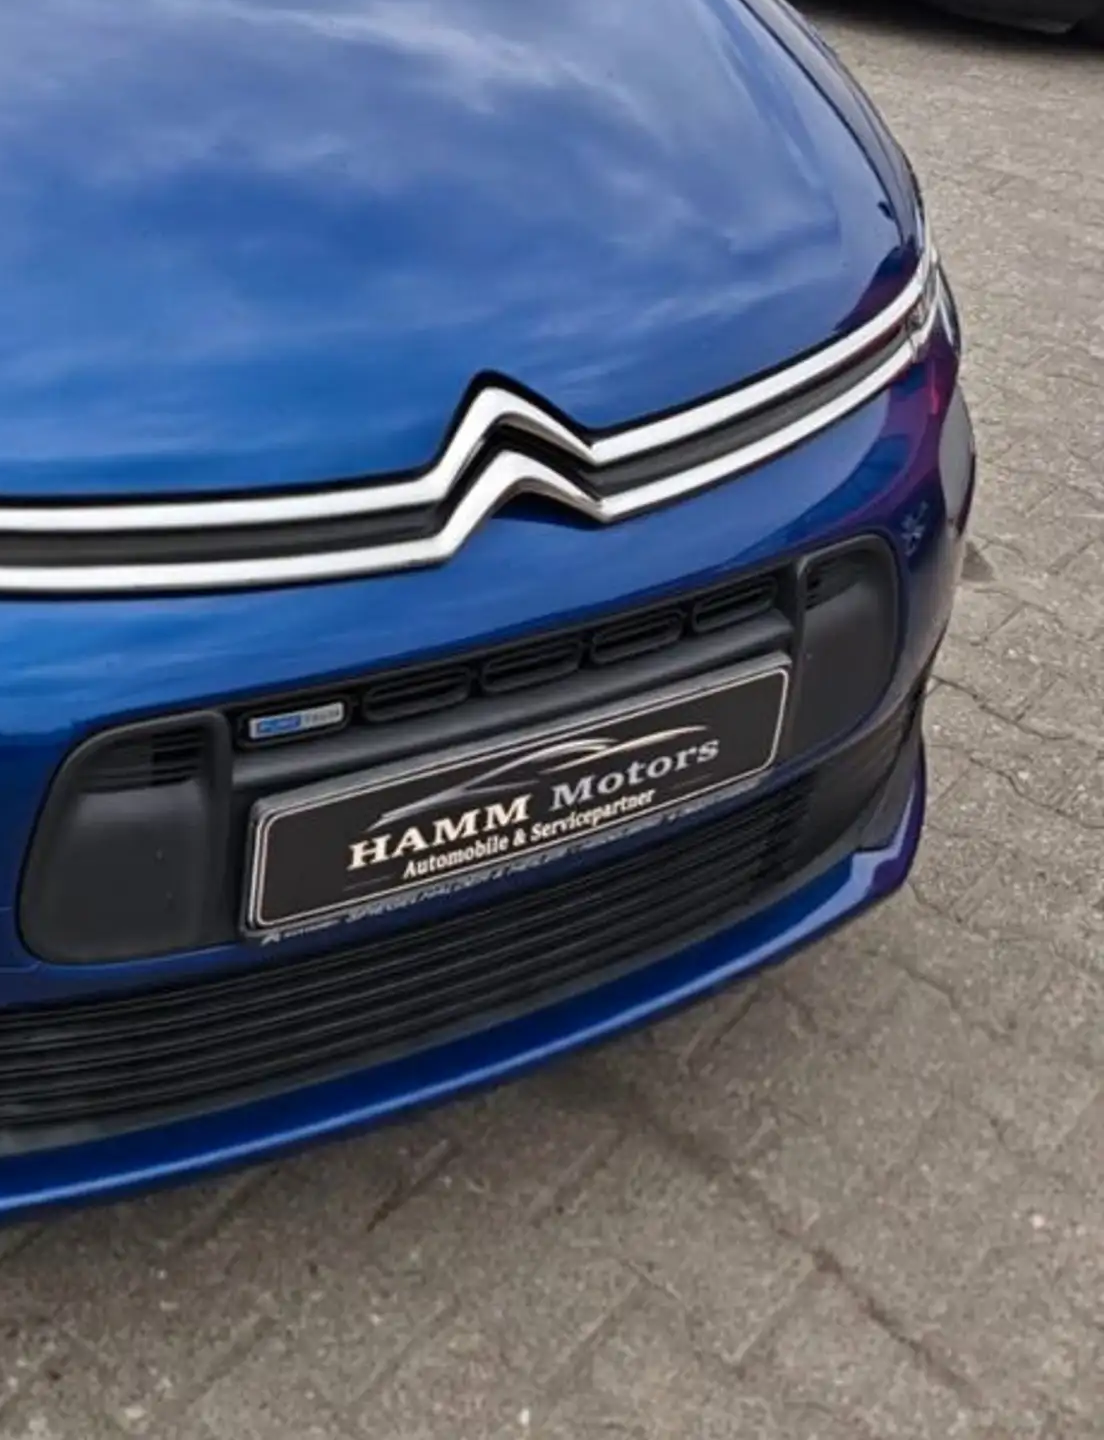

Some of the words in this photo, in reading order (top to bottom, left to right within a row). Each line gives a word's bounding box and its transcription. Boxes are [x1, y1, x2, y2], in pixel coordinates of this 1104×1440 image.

[346, 794, 533, 871] HAMM
[549, 739, 720, 810] Motors
[401, 835, 509, 880] Automobile
[512, 827, 527, 847] &
[530, 788, 657, 841] Servicepartner
